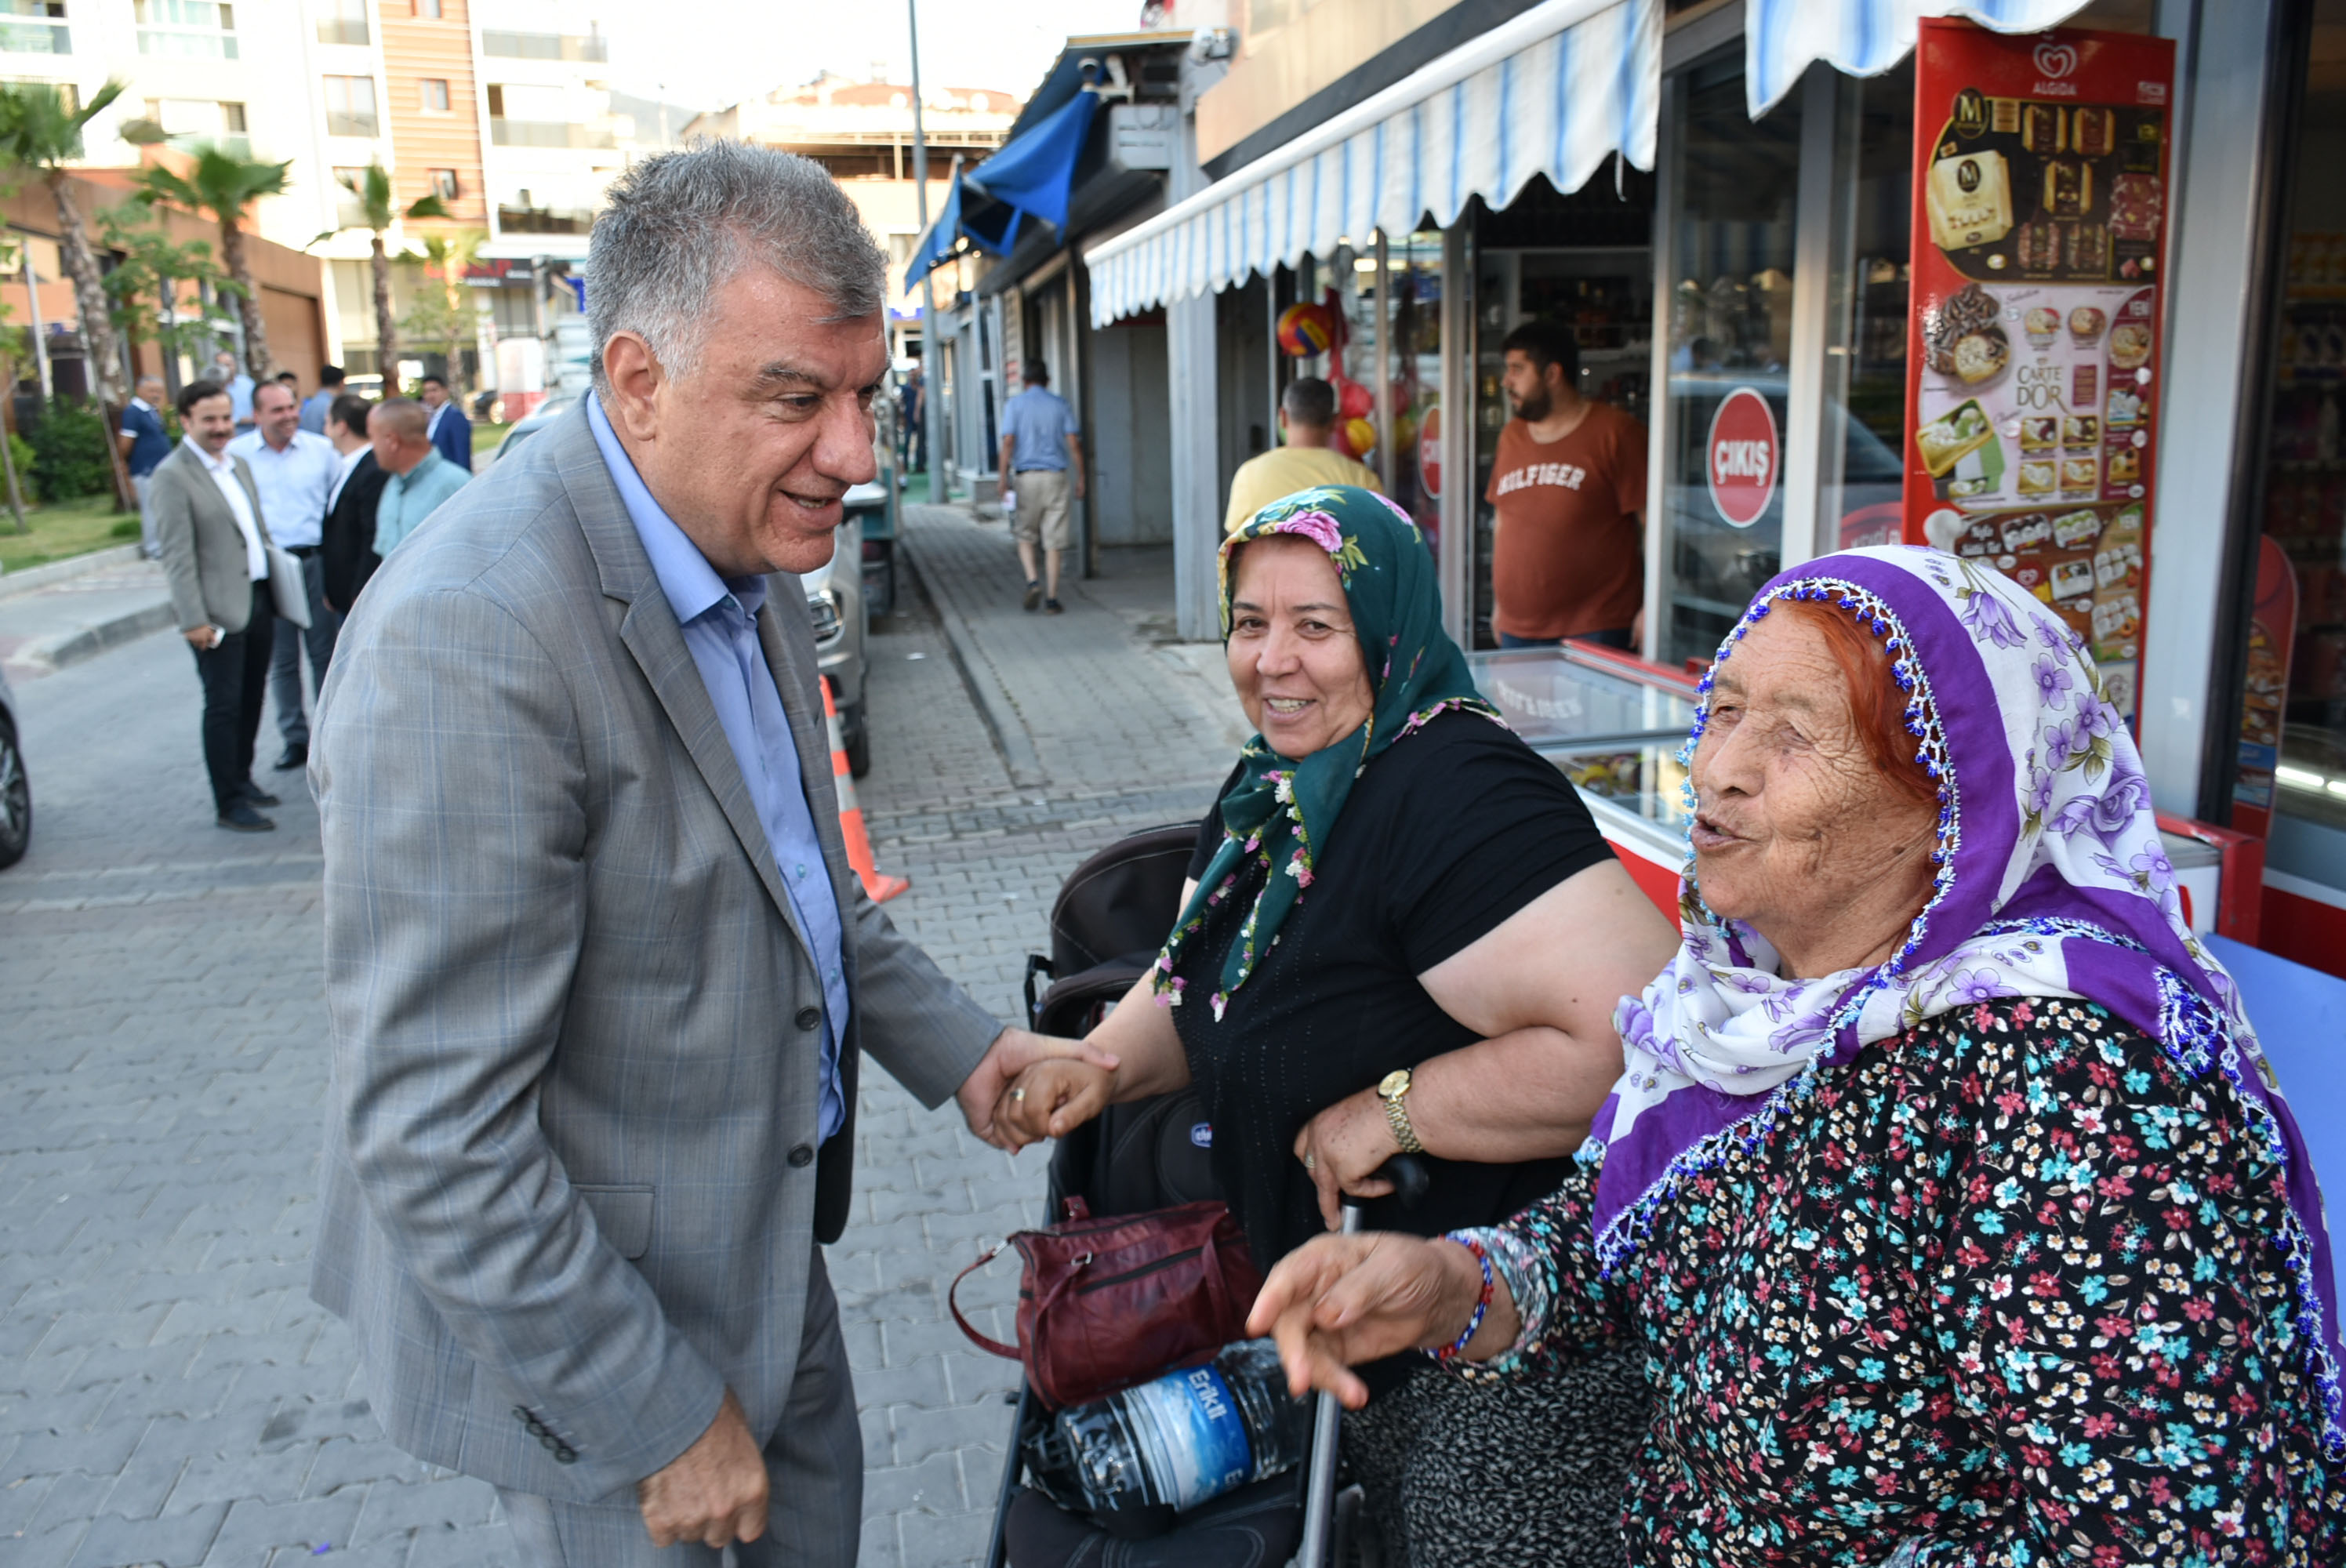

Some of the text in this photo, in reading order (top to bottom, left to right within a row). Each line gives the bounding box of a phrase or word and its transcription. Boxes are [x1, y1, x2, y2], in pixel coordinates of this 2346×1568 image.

[2017, 365, 2063, 384] CARTE
[2017, 383, 2069, 414] D'OR
[1496, 462, 1586, 495] HILFIGER
[1715, 440, 1770, 486] ÇIKIŞ
[1188, 1369, 1227, 1421] Erikli
